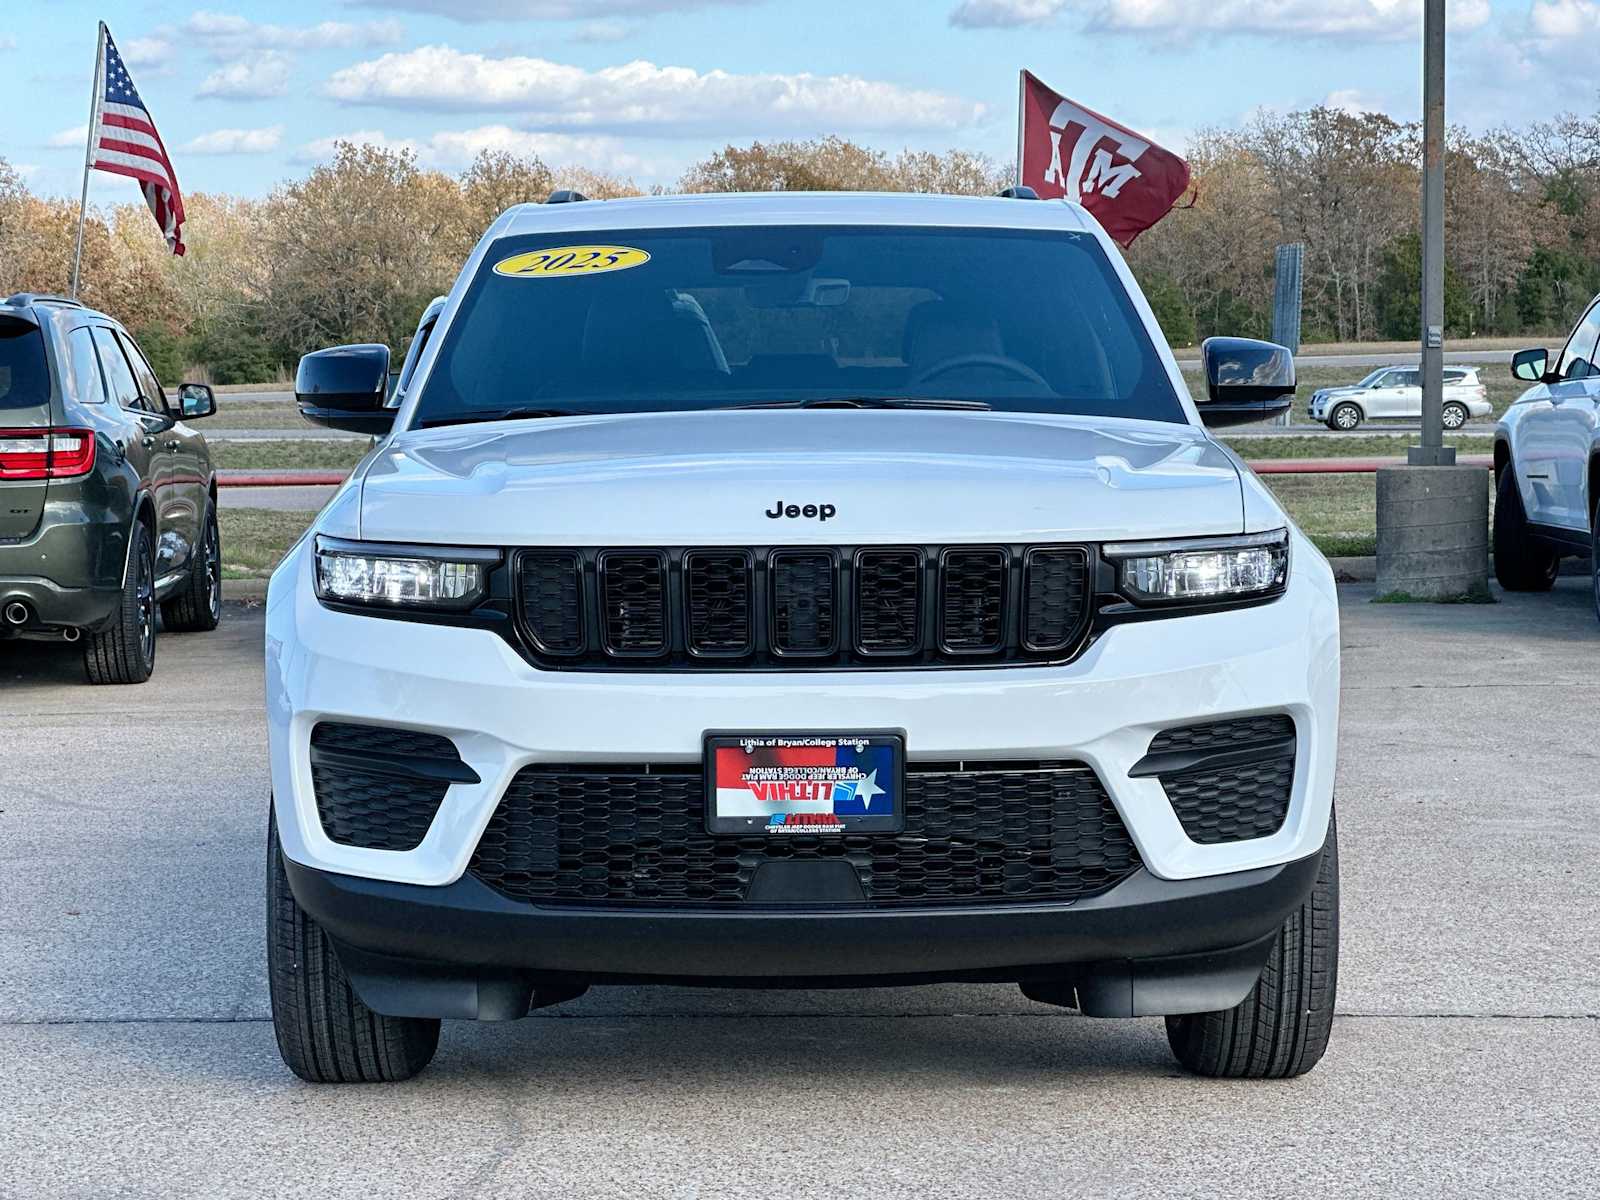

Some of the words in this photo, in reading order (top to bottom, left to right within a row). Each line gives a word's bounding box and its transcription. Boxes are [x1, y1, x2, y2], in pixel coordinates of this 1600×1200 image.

[514, 251, 630, 274] 2025
[765, 500, 836, 521] Jeep
[740, 738, 765, 747] Lithia
[766, 738, 777, 747] of
[777, 738, 837, 748] Bryan/College
[837, 738, 870, 746] Station
[747, 780, 833, 801] LITHIA
